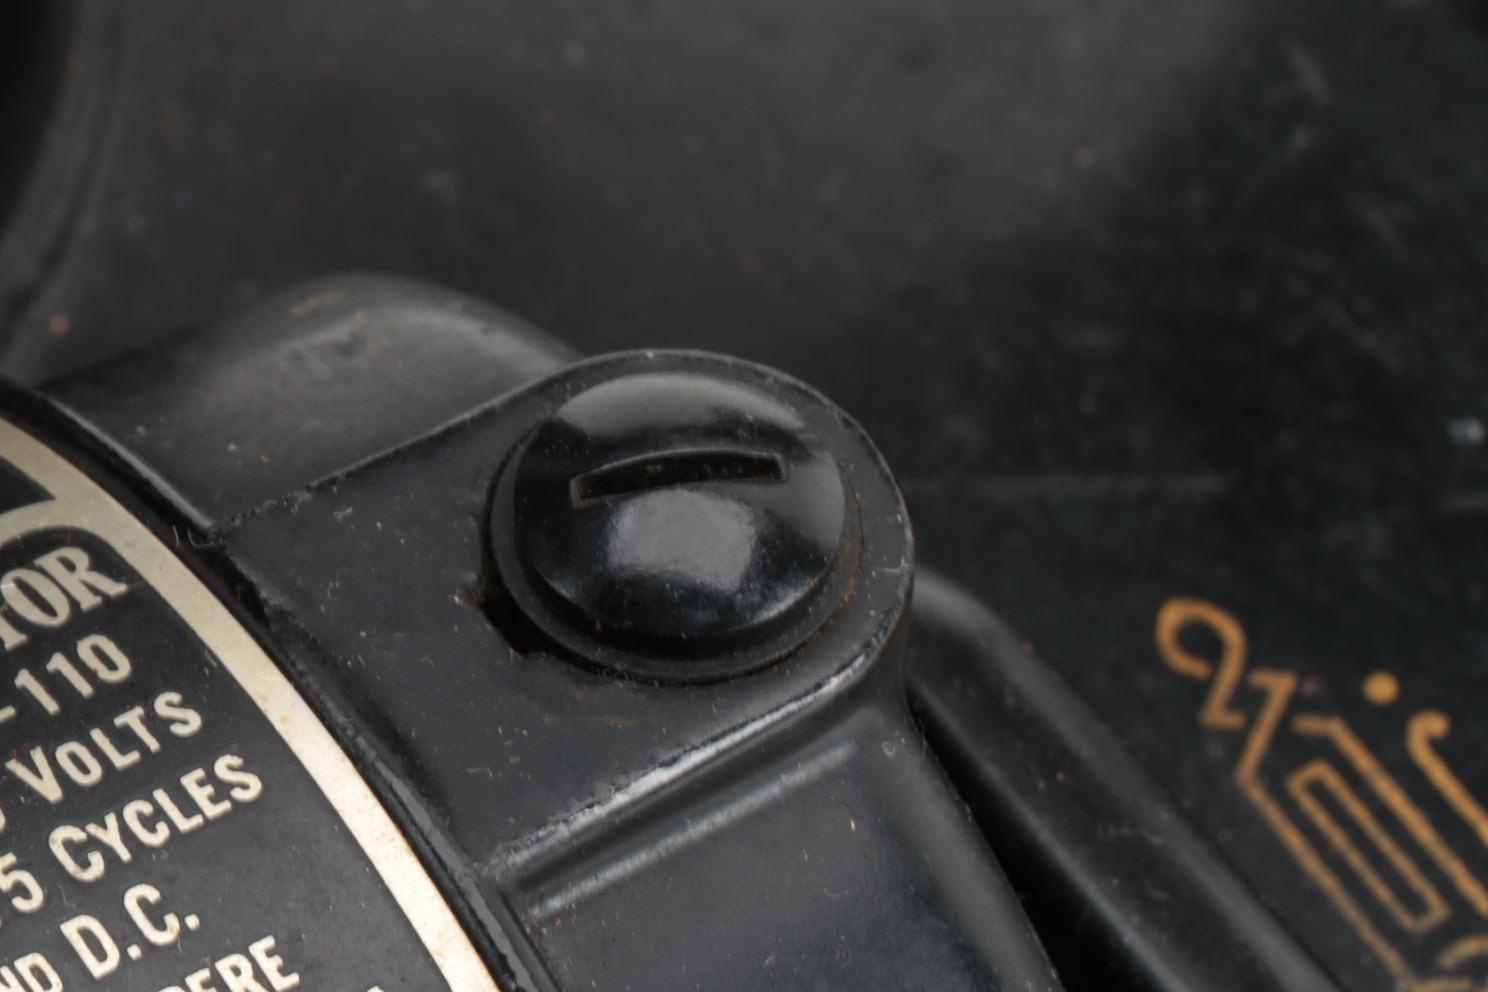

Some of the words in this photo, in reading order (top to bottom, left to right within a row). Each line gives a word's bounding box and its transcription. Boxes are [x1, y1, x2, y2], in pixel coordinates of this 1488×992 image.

[5, 691, 203, 804] VOLTS
[48, 753, 263, 882] CYCLES
[60, 884, 200, 979] D.C.
